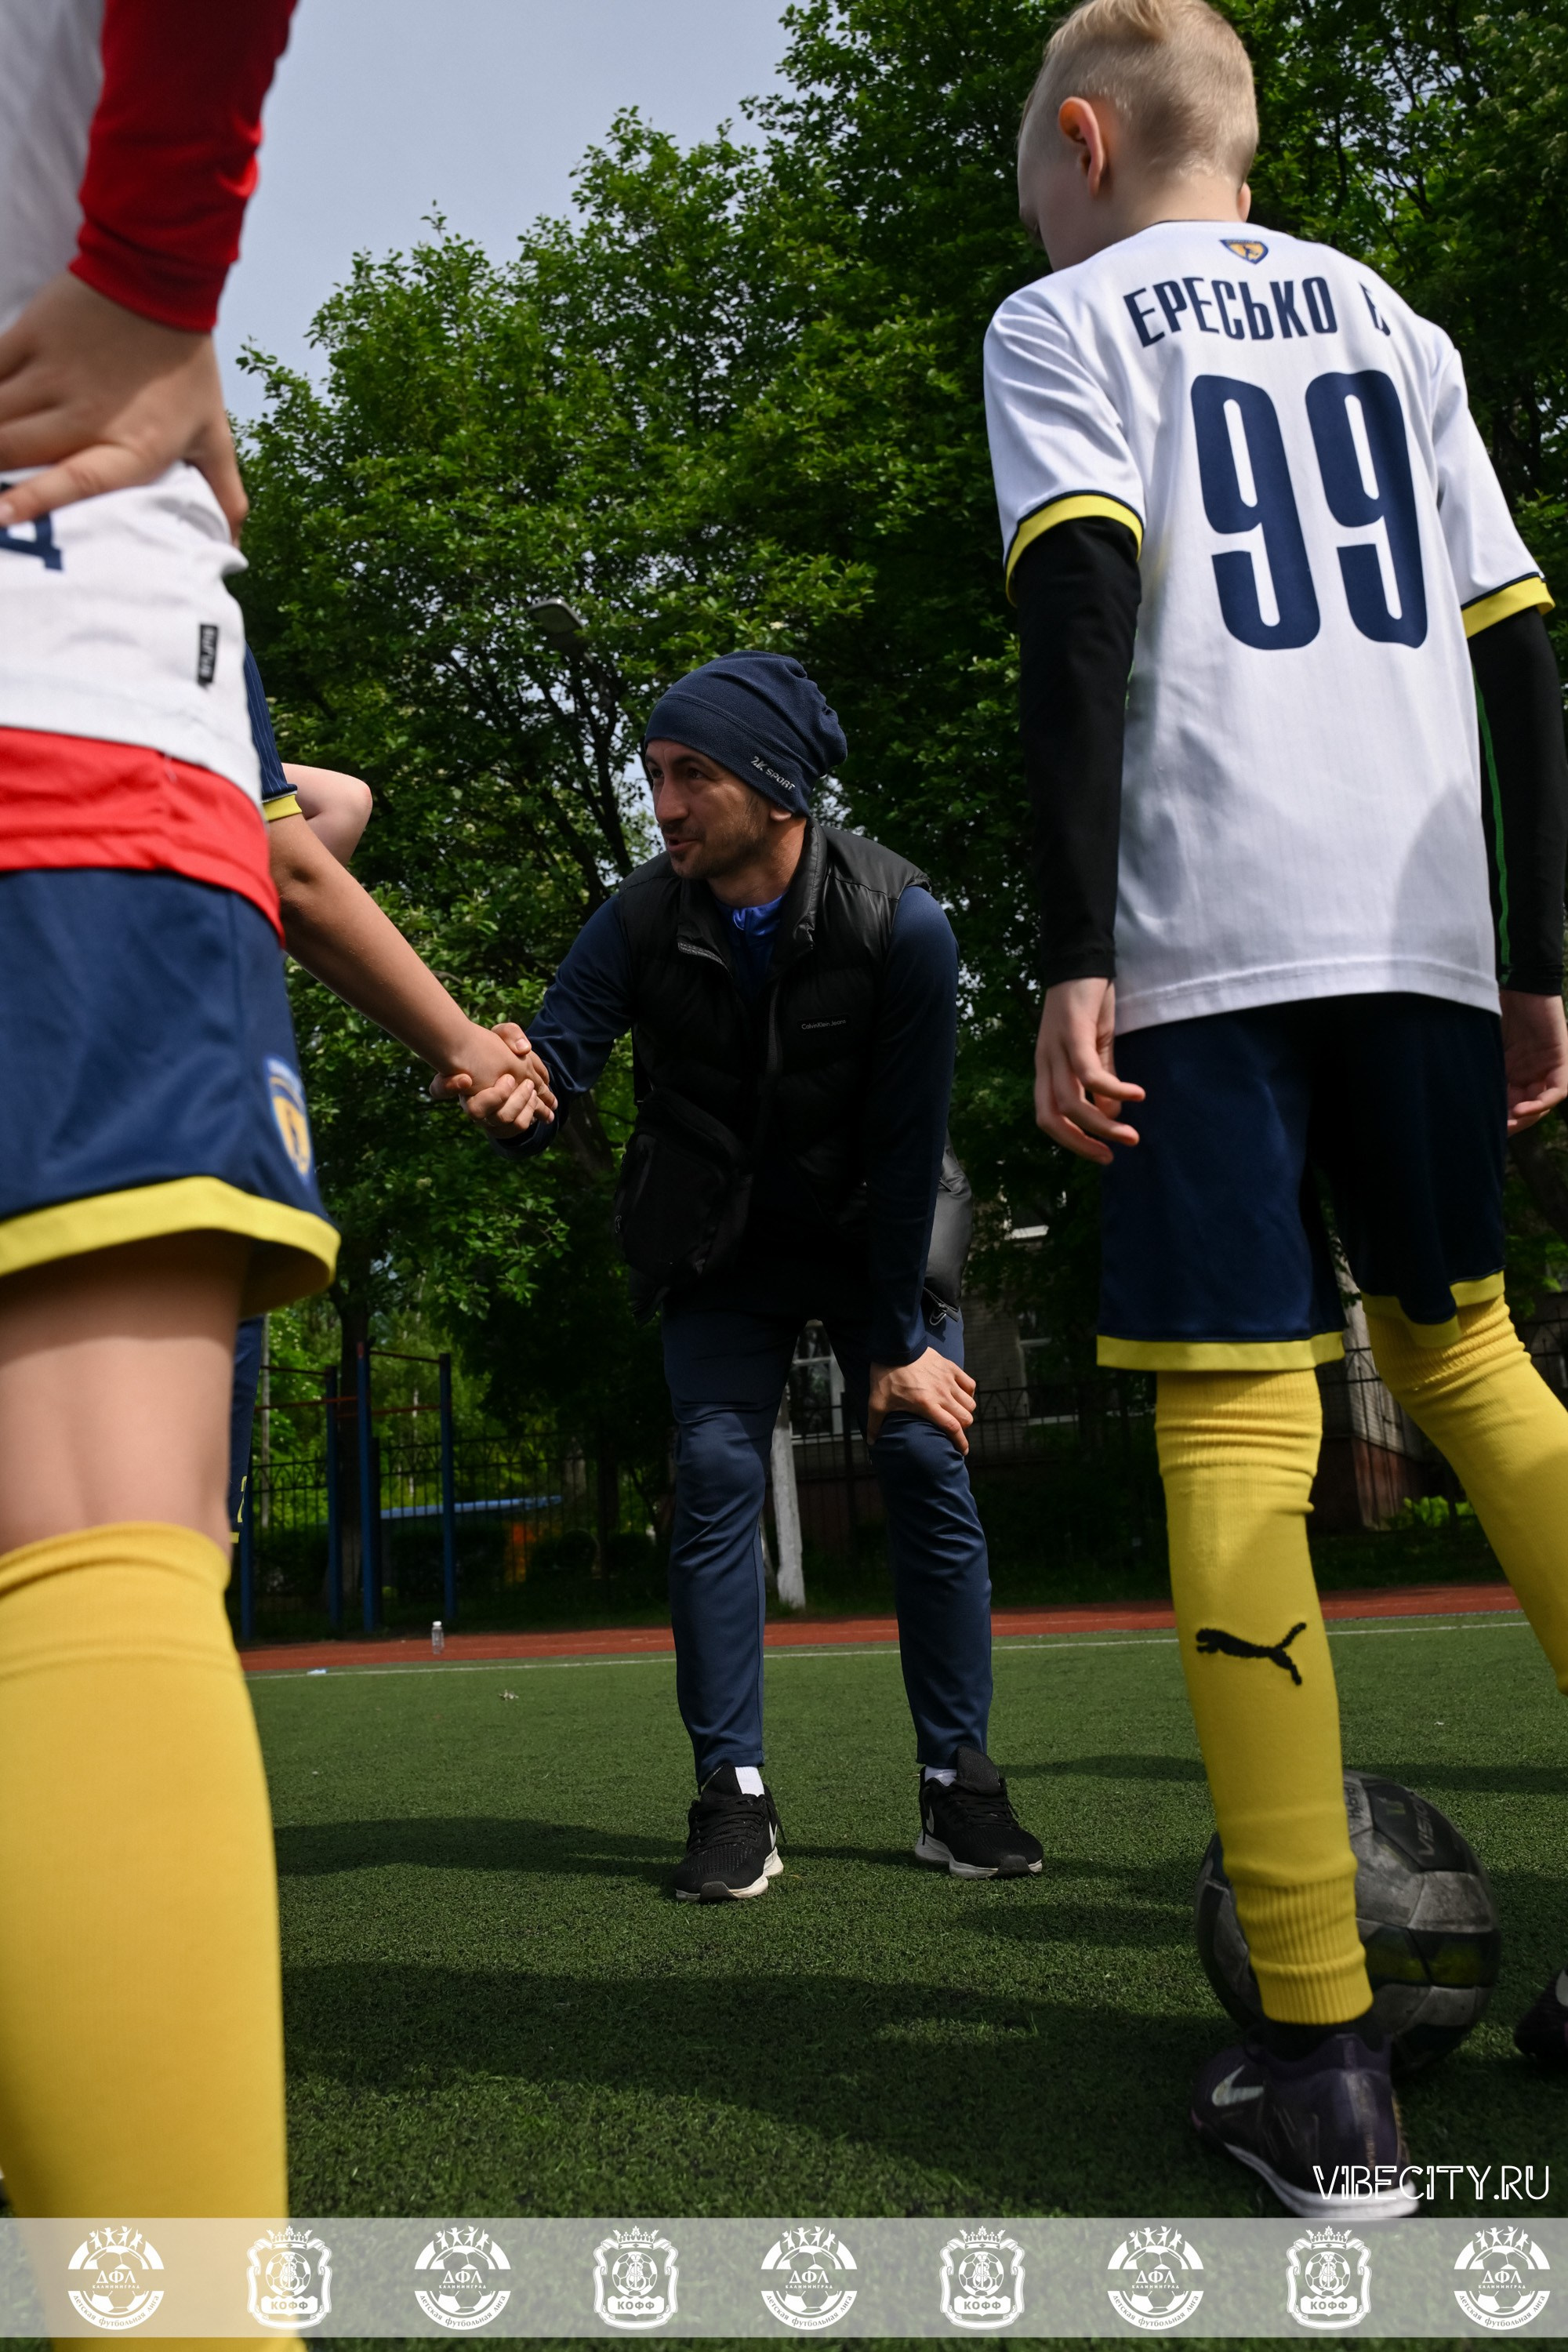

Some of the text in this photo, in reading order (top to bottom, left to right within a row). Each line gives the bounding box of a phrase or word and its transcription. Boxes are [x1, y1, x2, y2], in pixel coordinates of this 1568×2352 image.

[1123, 277, 1338, 347] ЕРЕСЬКО
[1190, 369, 1428, 650] 99
[765, 768, 796, 791] SPORT
